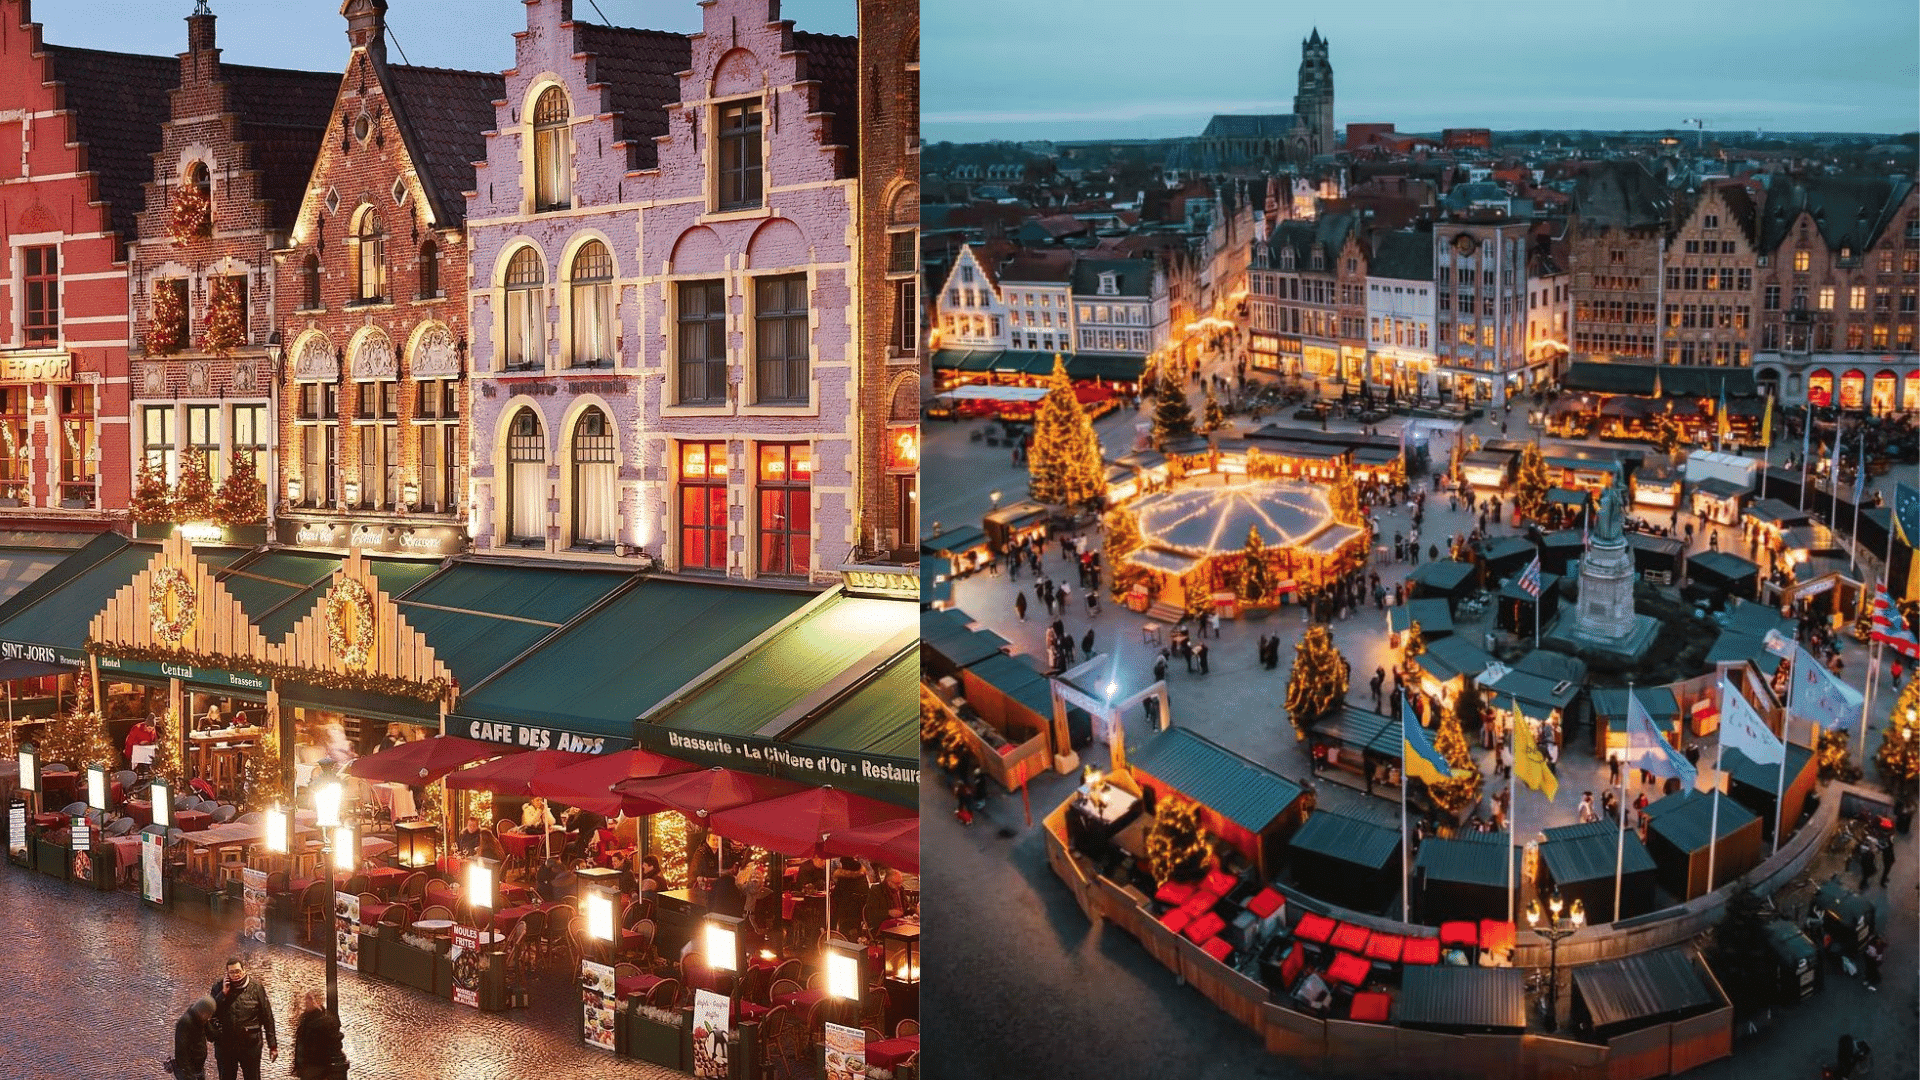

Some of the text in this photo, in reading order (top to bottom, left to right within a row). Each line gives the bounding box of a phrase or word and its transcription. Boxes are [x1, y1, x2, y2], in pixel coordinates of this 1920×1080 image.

[33, 358, 70, 379] D'OR
[1, 642, 86, 667] SINT-JORIS Brasserie
[101, 657, 263, 688] Hotel Central Brasserie
[470, 720, 605, 755] CAFE DES ARTS
[668, 731, 733, 754] Brasserie
[743, 743, 762, 760] La
[816, 756, 848, 775] d'Or
[453, 925, 478, 939] MOULES
[455, 936, 476, 949] FRITES
